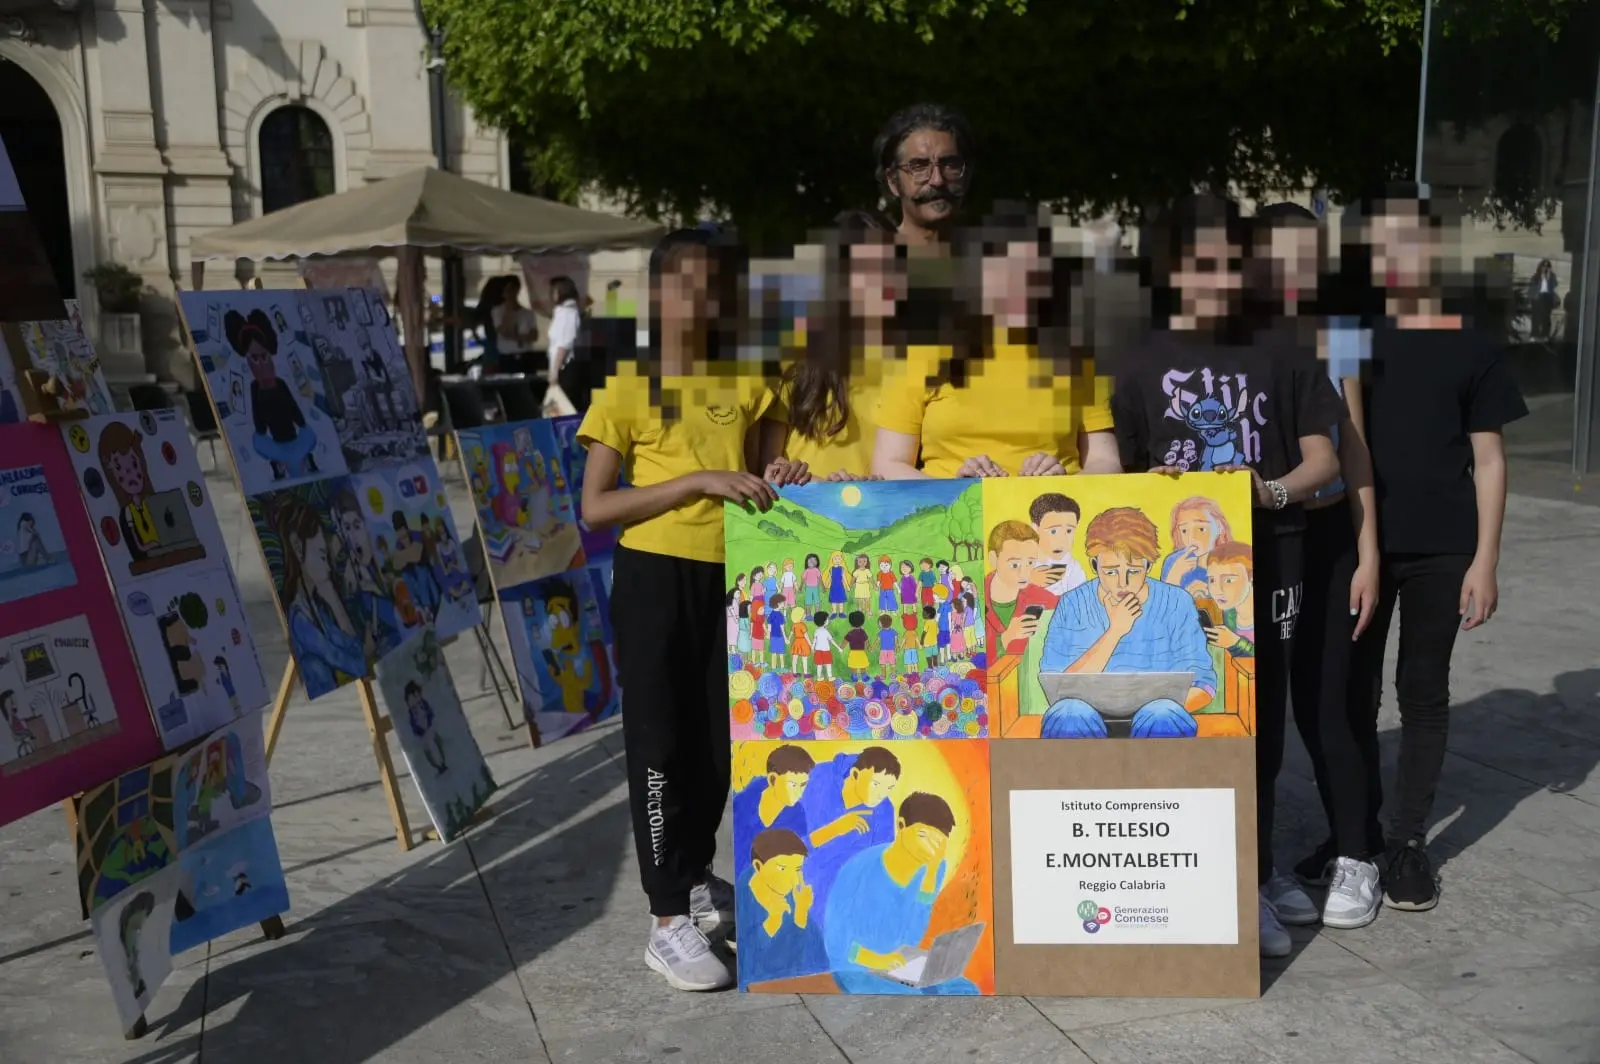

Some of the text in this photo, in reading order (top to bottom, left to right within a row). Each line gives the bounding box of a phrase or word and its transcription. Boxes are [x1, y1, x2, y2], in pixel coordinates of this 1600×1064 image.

[1061, 800, 1180, 814] Istituto Comprensivo
[1072, 822, 1170, 838] B. TELESIO
[1046, 852, 1199, 868] E.MONTALBETTI
[1079, 879, 1166, 893] Reggio Calabria
[1114, 905, 1169, 915] Generazioni
[1114, 914, 1169, 924] Connesse
